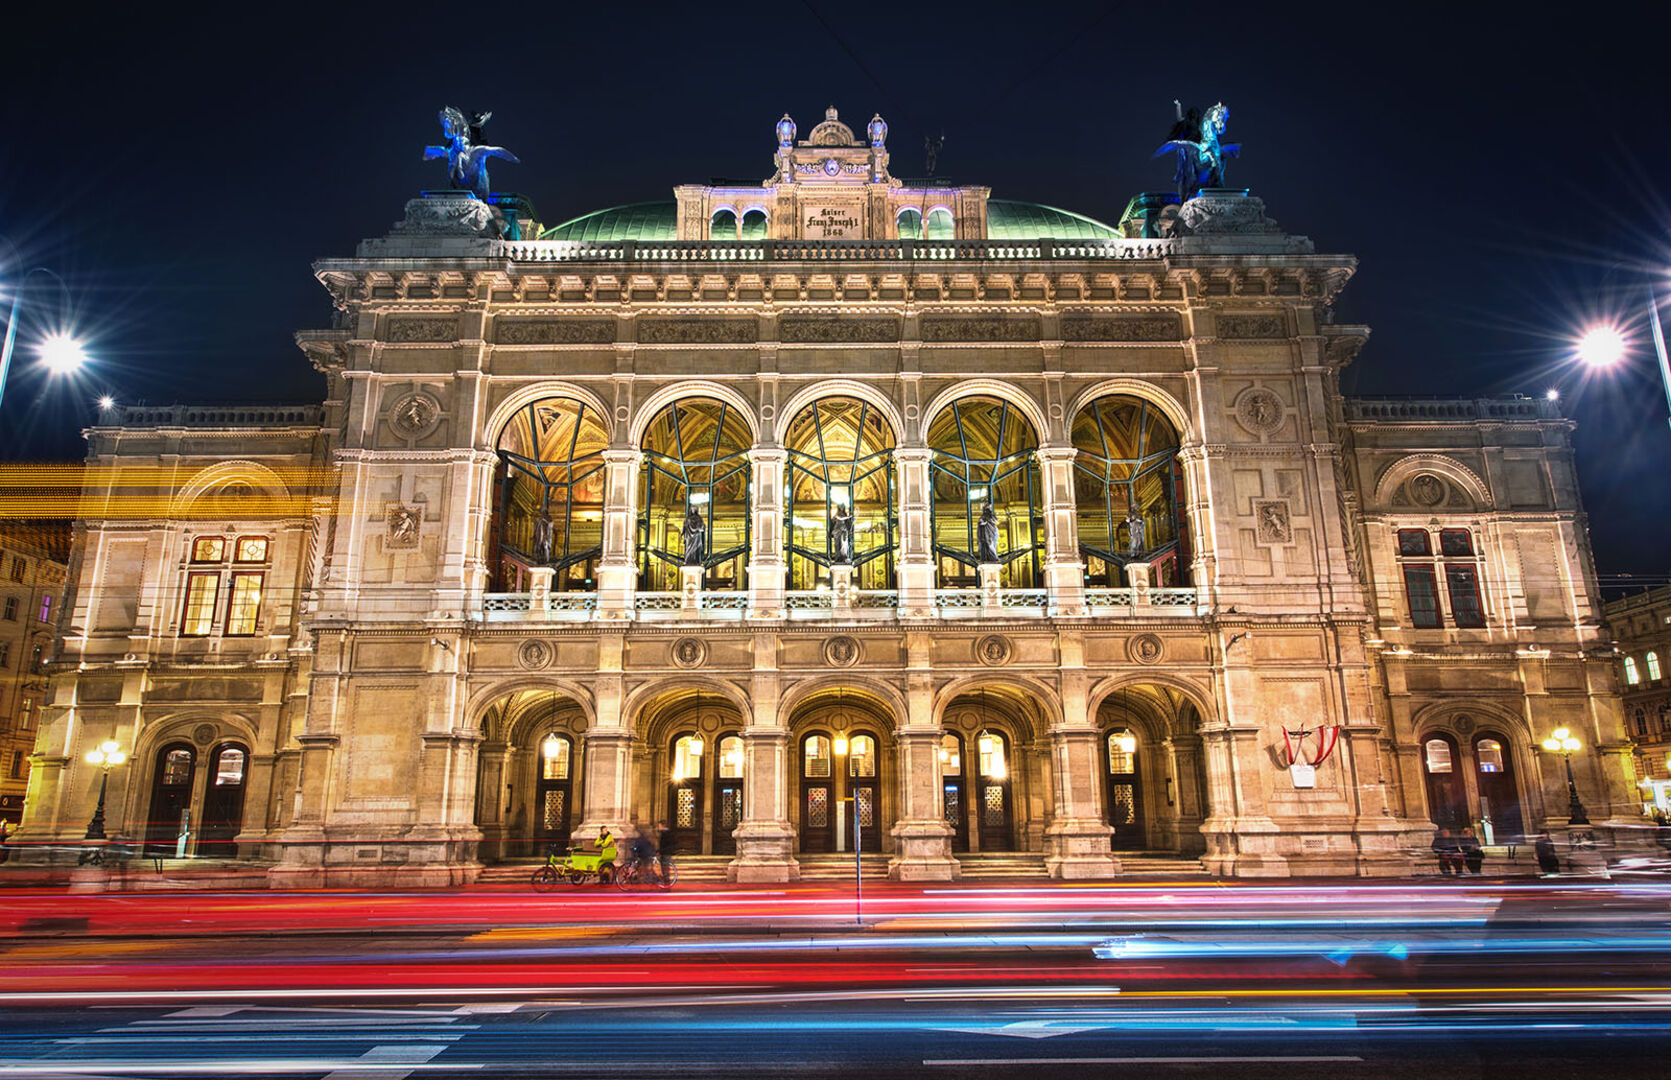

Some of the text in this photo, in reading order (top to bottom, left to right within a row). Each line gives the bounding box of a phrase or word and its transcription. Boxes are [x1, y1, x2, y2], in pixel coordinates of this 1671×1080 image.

[820, 208, 846, 216] Kaiser
[806, 216, 827, 229] Franz
[828, 216, 854, 230] Joseph
[823, 229, 844, 237] 1868
